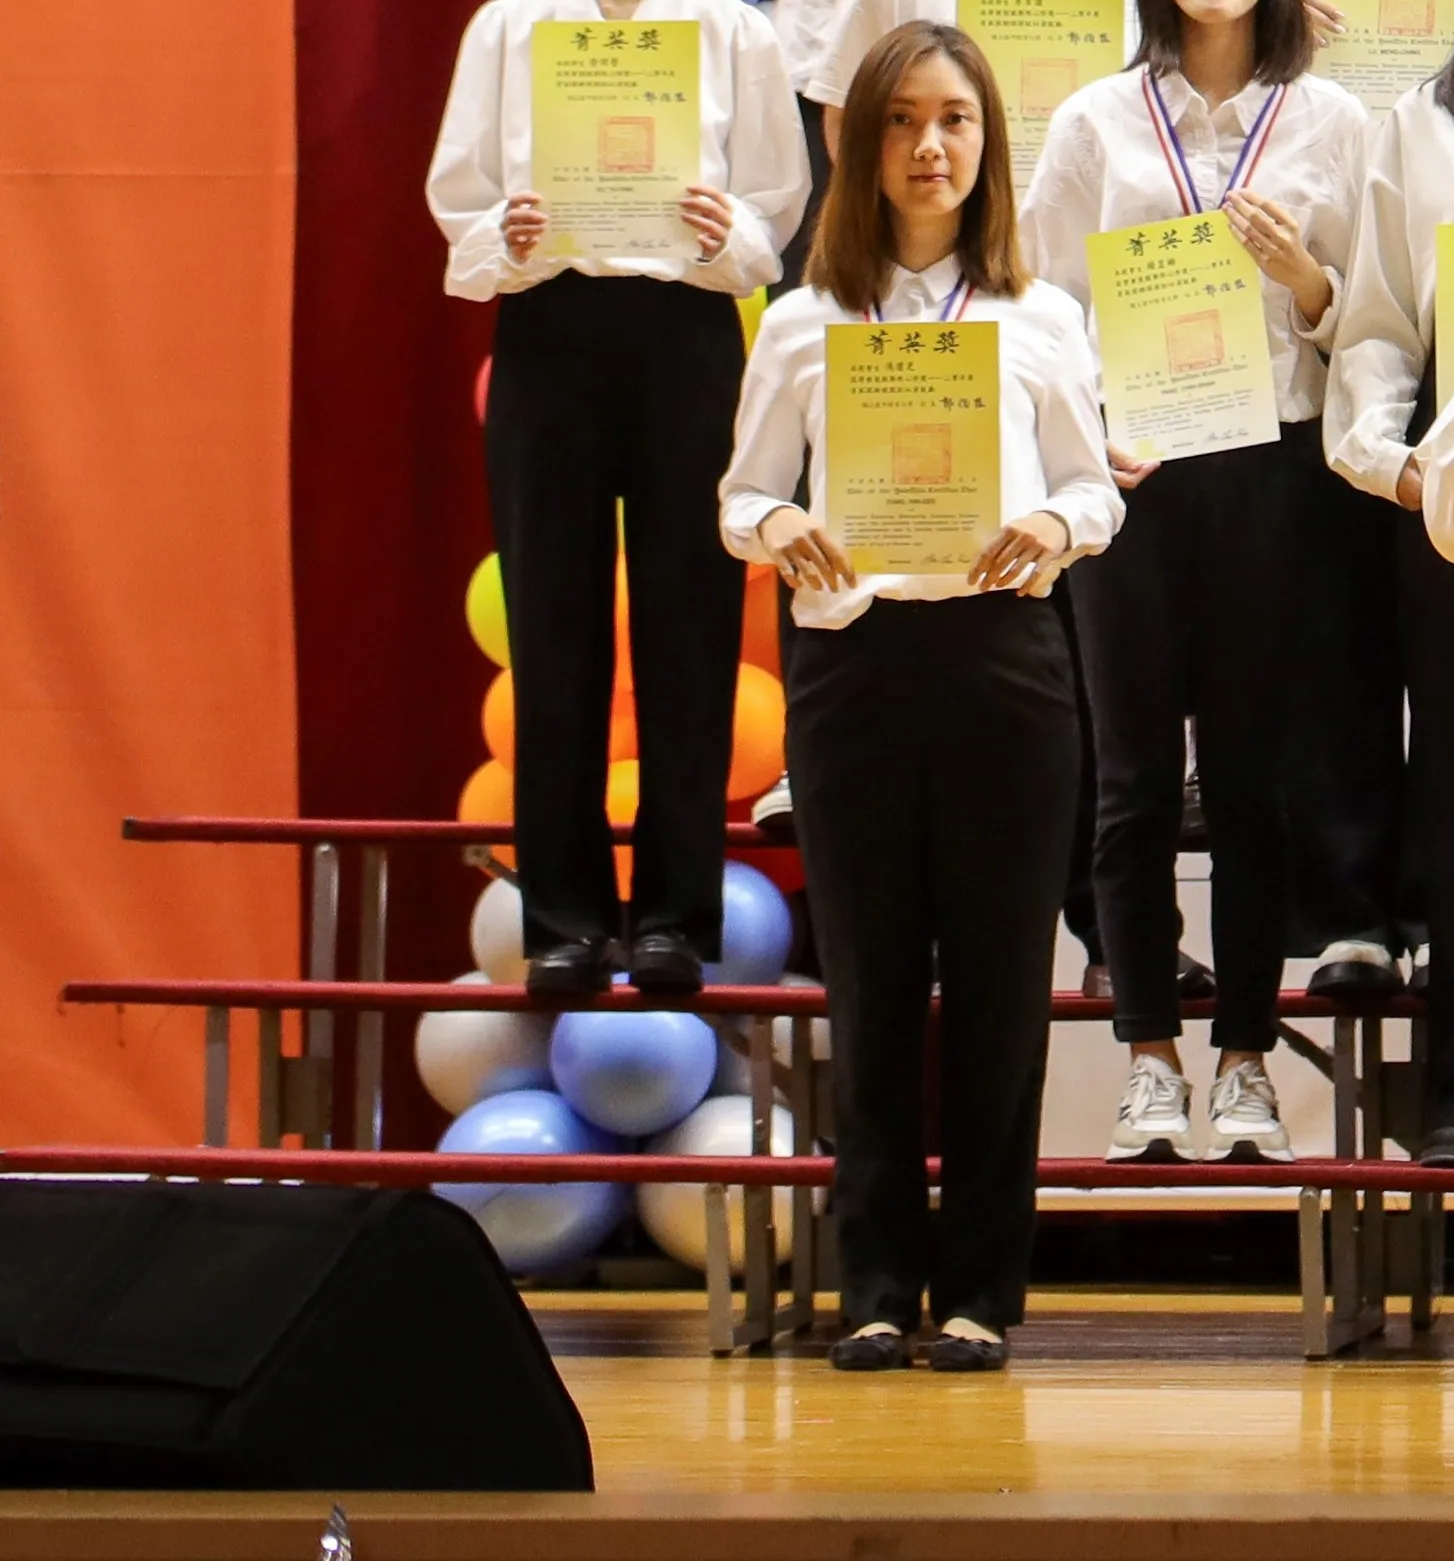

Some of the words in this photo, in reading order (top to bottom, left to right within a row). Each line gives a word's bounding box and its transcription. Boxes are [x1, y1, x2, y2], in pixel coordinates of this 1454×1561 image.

[571, 27, 661, 52] 菁英獎
[1126, 221, 1215, 257] 菁英獎
[865, 330, 960, 355] 菁英獎
